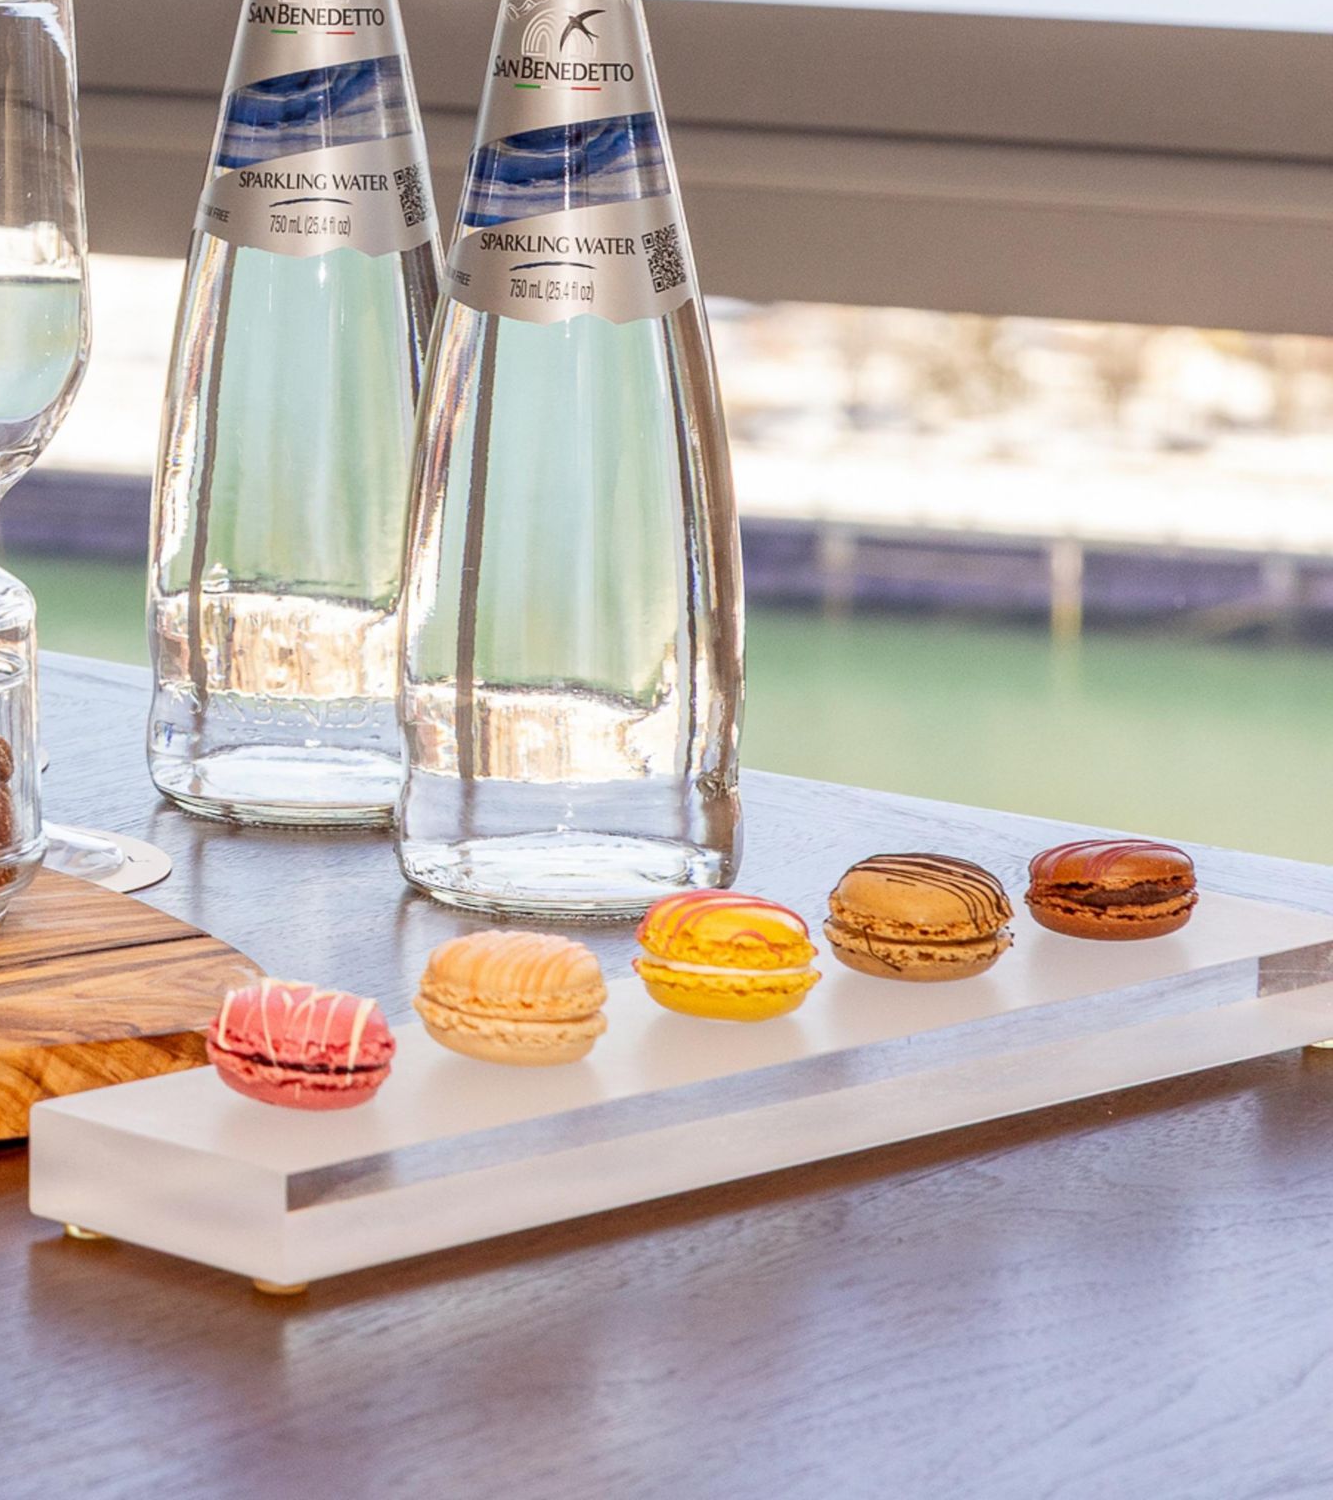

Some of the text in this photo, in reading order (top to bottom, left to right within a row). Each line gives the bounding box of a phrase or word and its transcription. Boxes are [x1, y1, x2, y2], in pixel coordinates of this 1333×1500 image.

[238, 170, 389, 192] SPARKLING WATER
[269, 214, 287, 234] 750
[288, 216, 303, 235] mL
[480, 232, 636, 256] SPARKLING WATER
[510, 278, 527, 299] 750
[528, 279, 544, 299] mL
